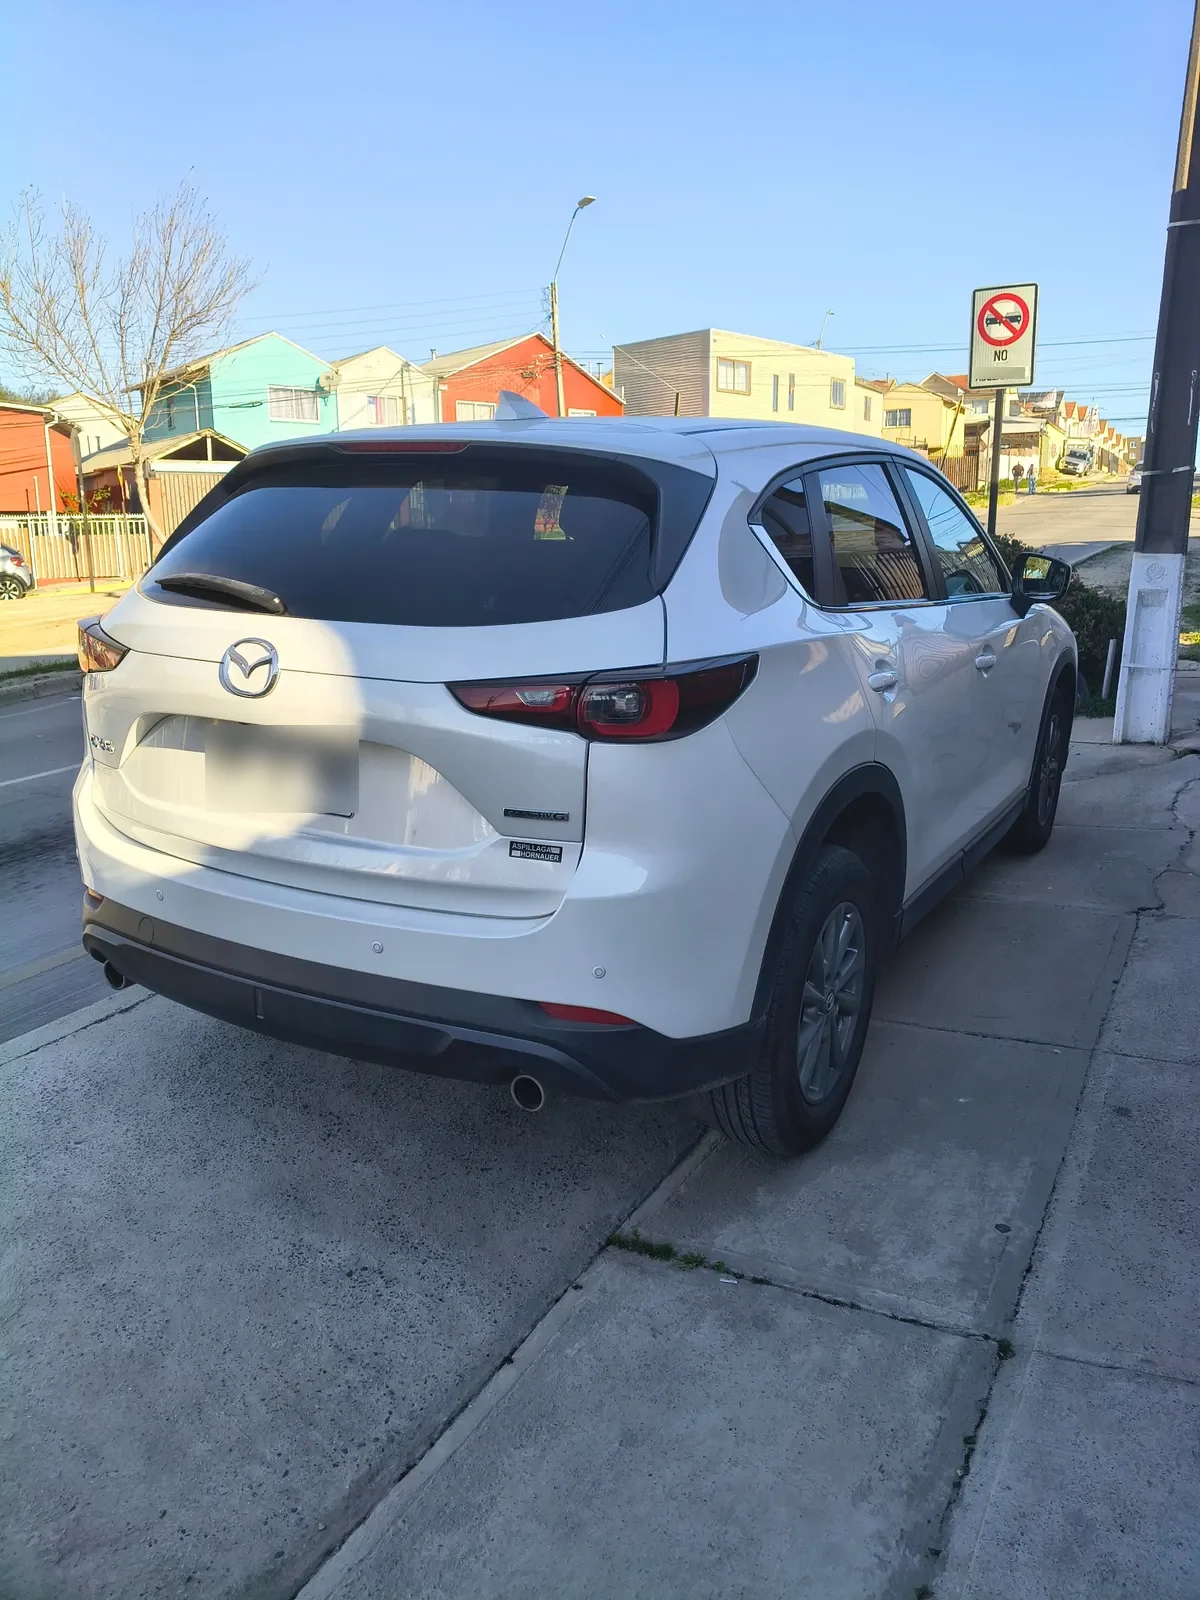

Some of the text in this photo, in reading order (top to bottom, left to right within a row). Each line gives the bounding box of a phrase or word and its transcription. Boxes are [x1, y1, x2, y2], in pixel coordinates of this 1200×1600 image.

[993, 349, 1008, 361] NO
[512, 843, 552, 853] ASPILLAGA
[520, 851, 560, 861] HORNAUER
